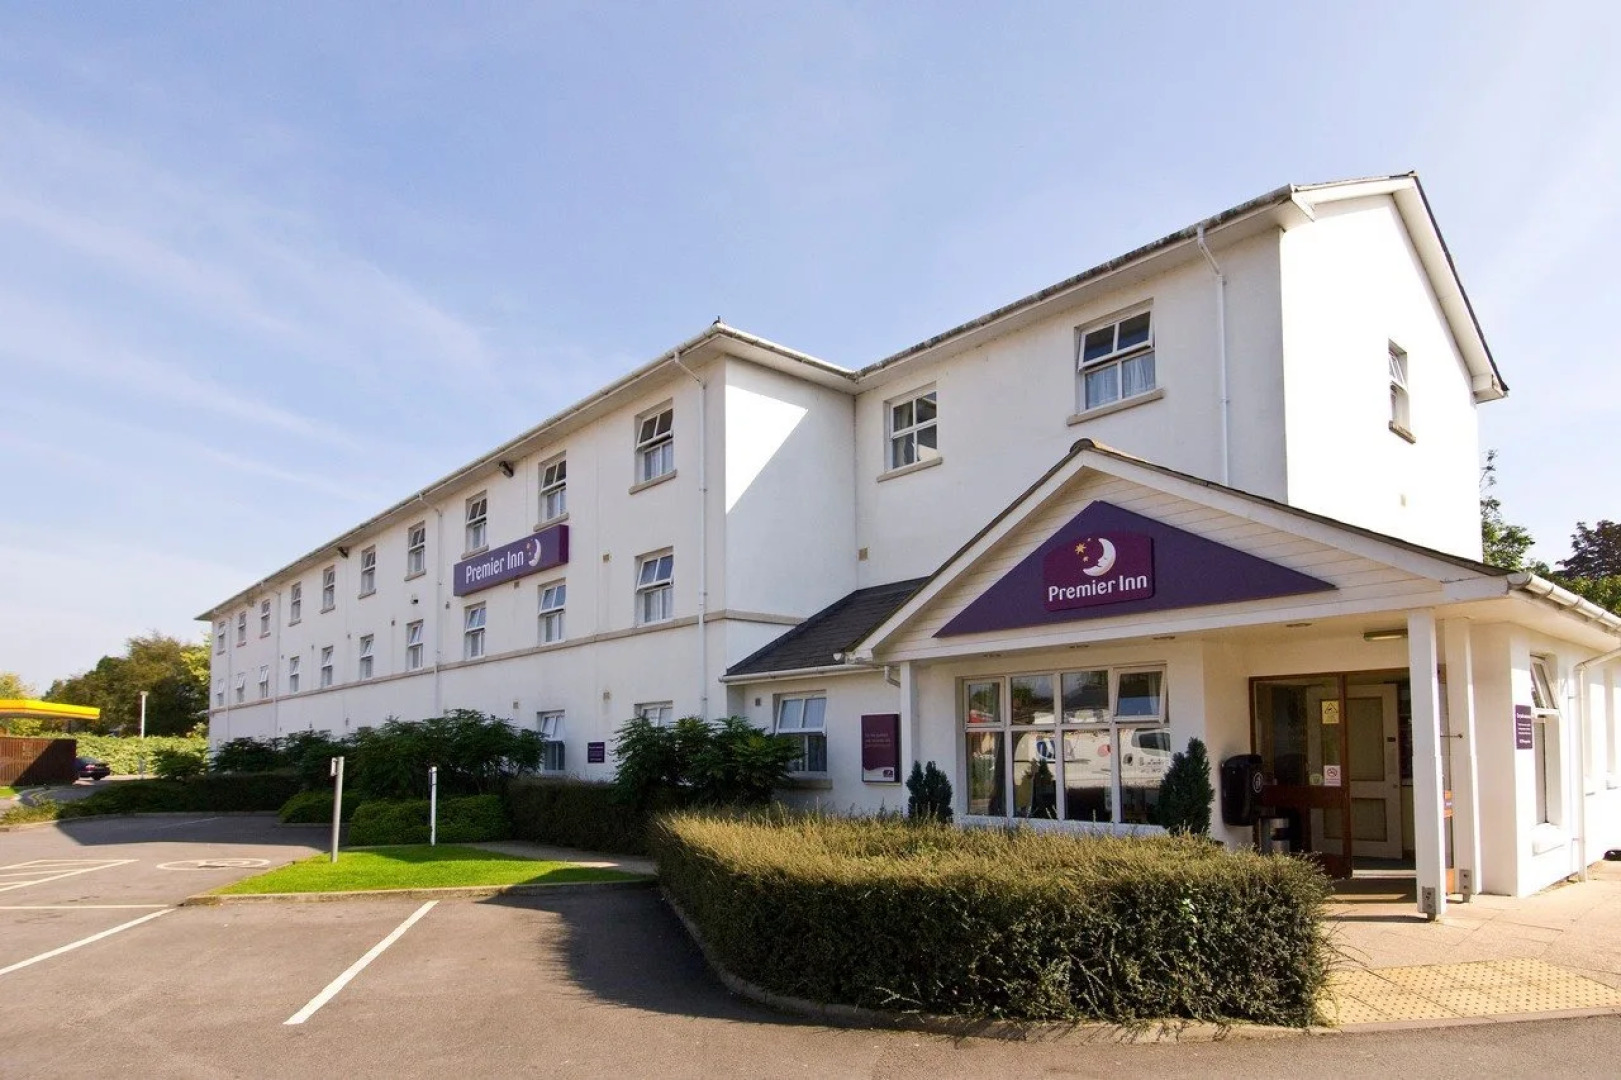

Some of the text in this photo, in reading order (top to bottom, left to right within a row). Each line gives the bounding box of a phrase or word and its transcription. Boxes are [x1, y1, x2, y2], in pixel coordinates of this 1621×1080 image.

[466, 551, 524, 584] Premier Inn
[1048, 575, 1147, 602] Premier Inn
